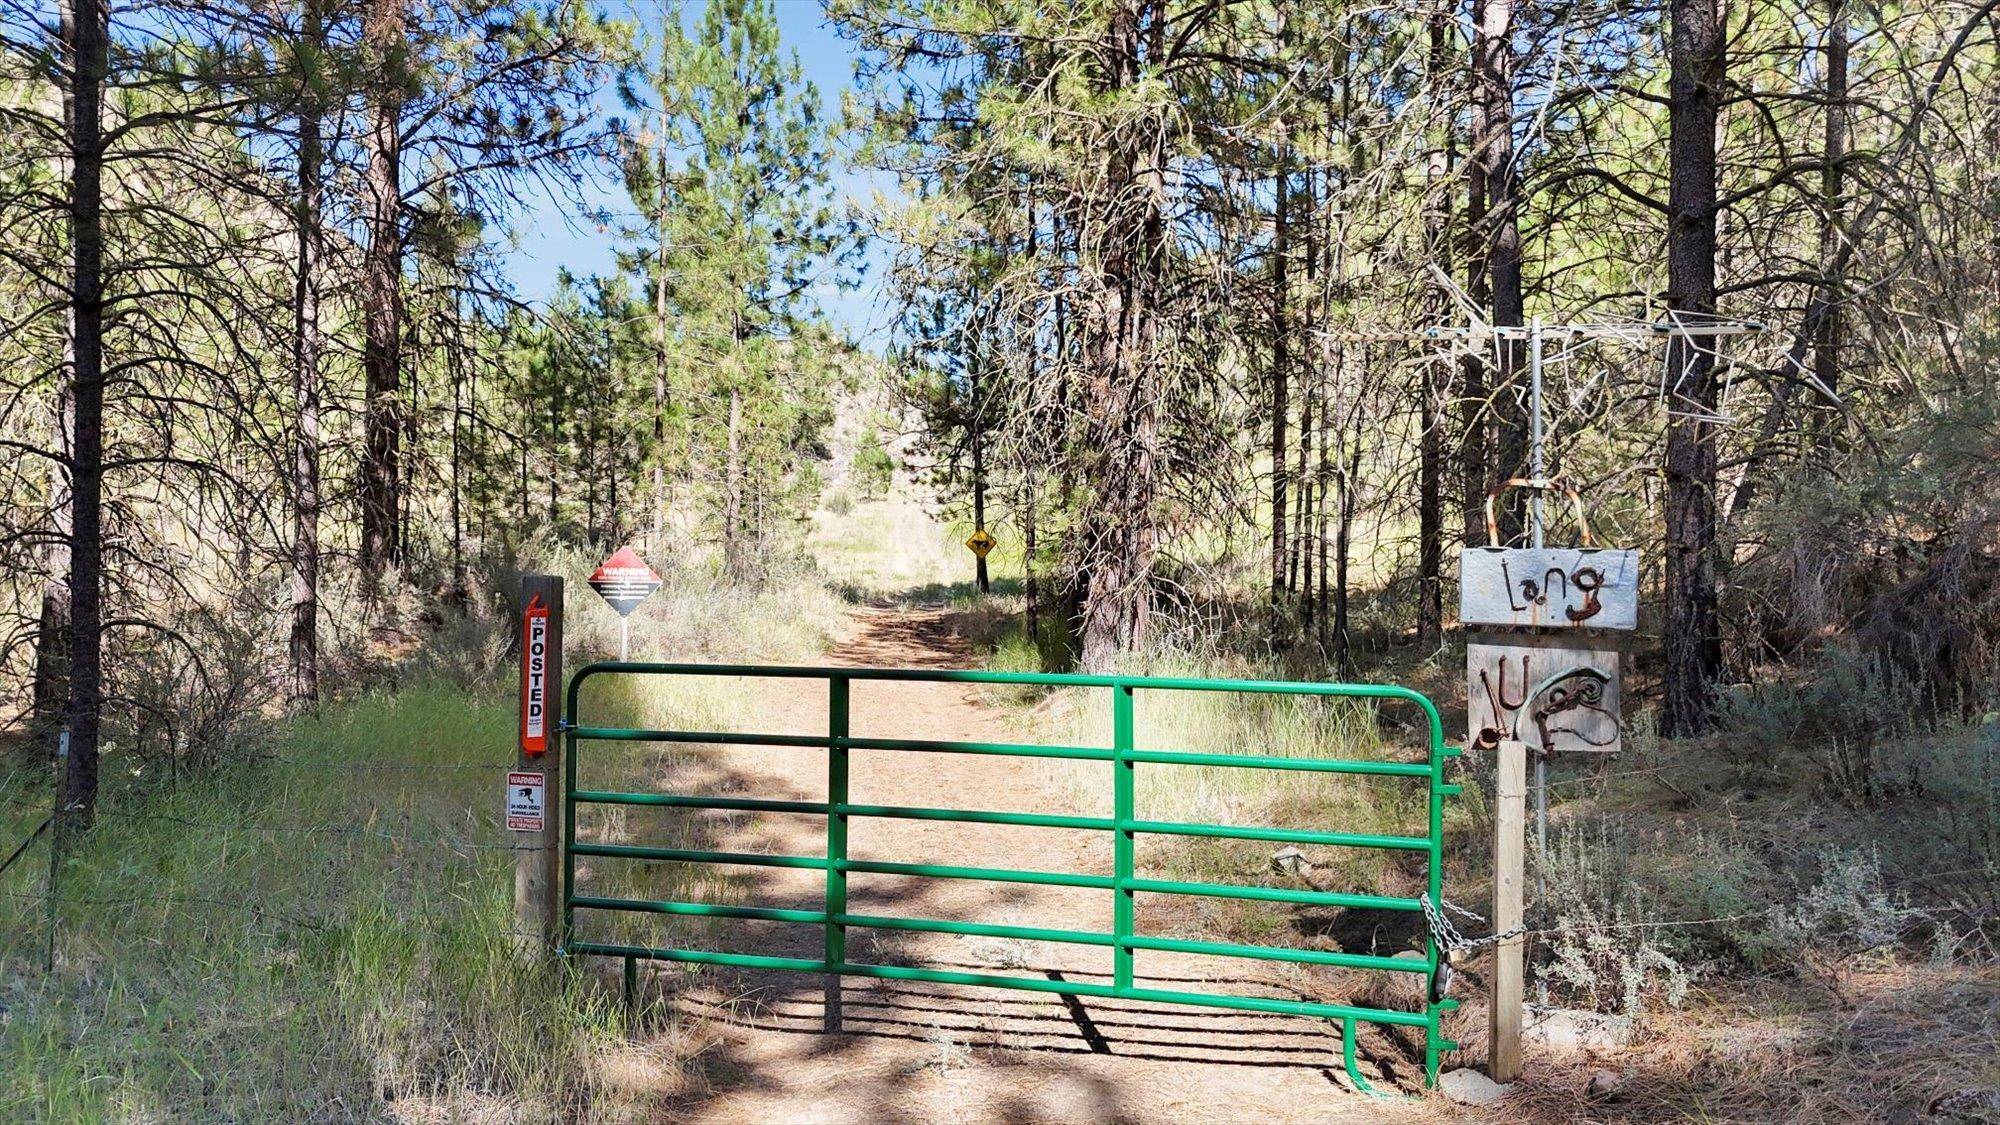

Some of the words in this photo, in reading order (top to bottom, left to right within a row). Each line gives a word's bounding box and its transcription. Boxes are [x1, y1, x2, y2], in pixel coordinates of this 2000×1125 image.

[604, 567, 650, 576] WARNING
[530, 627, 544, 717] POSTED
[510, 776, 542, 785] WARNING
